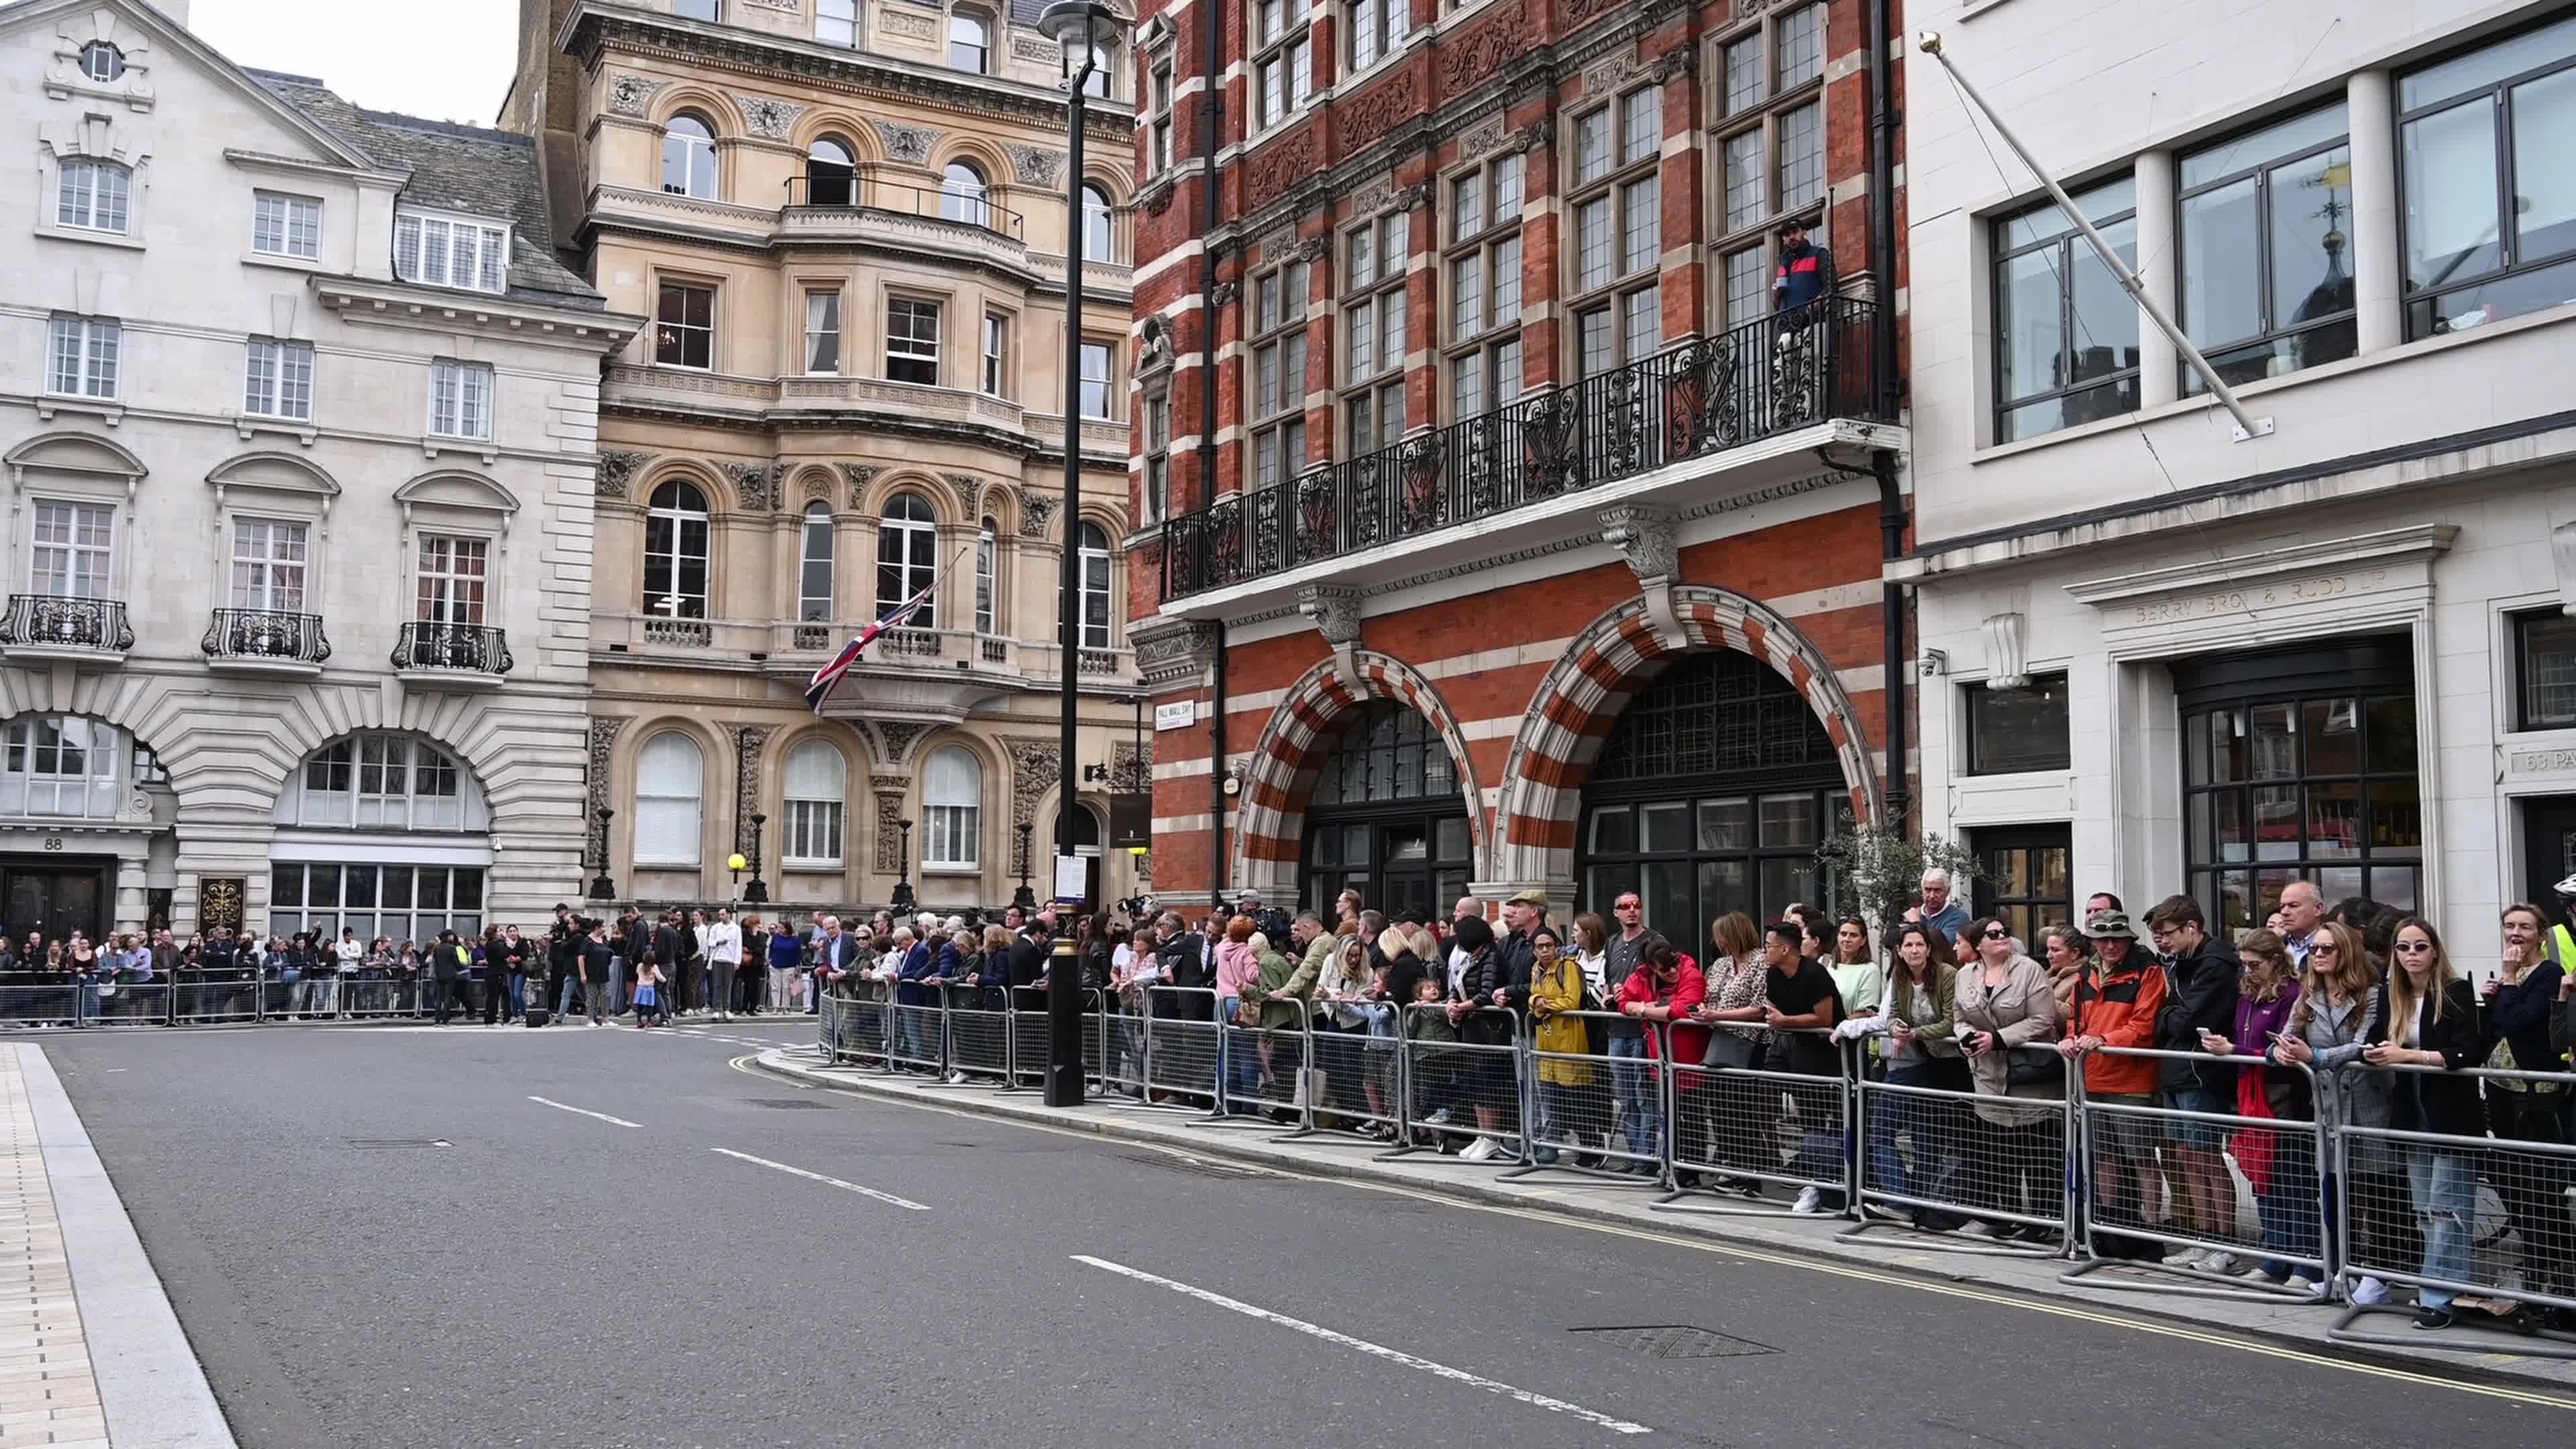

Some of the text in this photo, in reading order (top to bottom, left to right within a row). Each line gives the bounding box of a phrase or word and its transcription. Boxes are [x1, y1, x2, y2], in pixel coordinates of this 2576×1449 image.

[2135, 600, 2192, 623] BERRY
[2264, 588, 2275, 603] &
[2292, 576, 2347, 600] RUDD
[44, 838, 63, 851] 88
